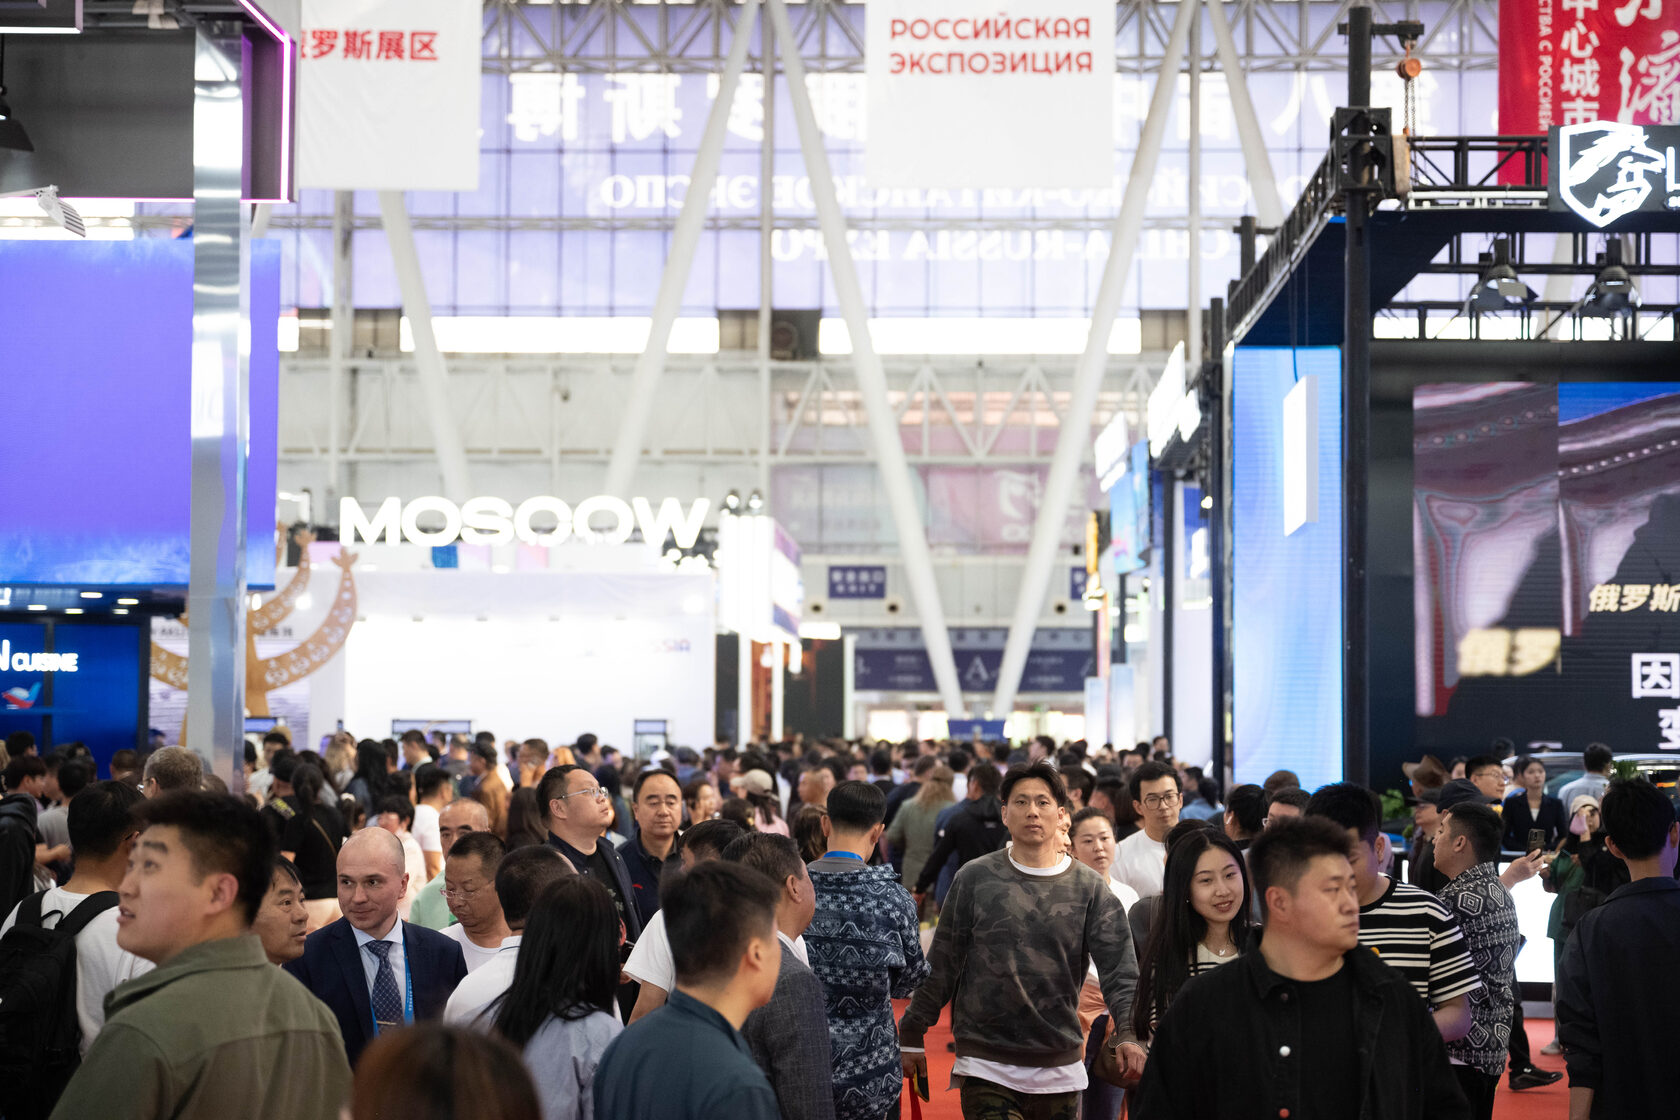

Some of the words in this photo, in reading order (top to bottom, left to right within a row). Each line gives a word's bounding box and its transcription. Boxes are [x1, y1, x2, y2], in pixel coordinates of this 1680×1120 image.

[890, 11, 1091, 40] РОССИЙСКАЯ
[300, 29, 439, 62] 罗斯展区
[889, 52, 1093, 76] ЭКСПОЗИЦИЯ
[339, 495, 711, 549] MOSCOW
[1589, 583, 1680, 612] 俄罗斯
[1631, 653, 1680, 699] 因
